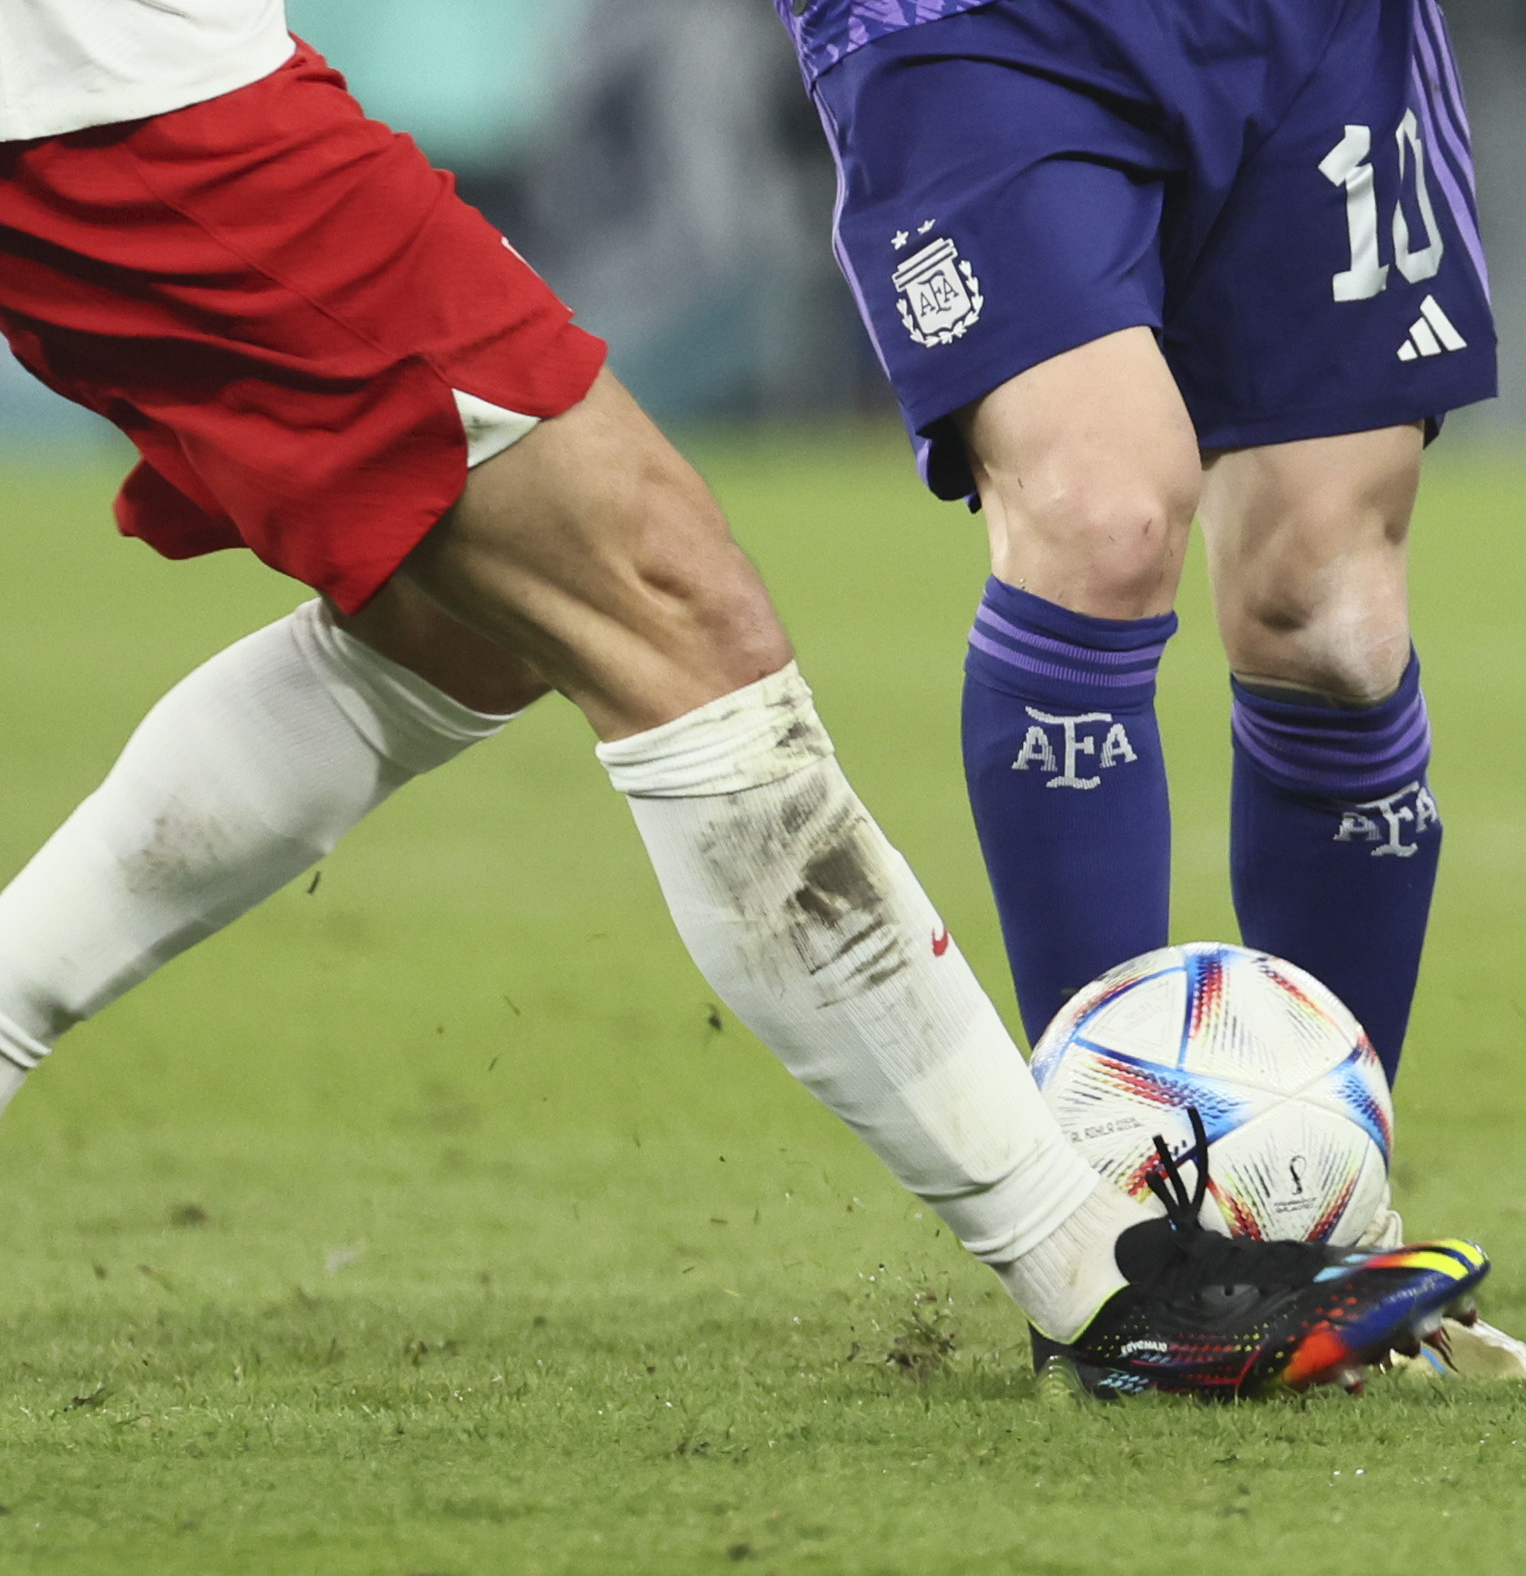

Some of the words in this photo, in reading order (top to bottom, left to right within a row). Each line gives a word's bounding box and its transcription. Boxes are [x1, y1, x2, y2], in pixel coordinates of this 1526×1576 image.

[1317, 107, 1445, 303] 10
[916, 269, 960, 317] AFA
[1011, 705, 1139, 790] AFA
[1333, 780, 1438, 858] AFA
